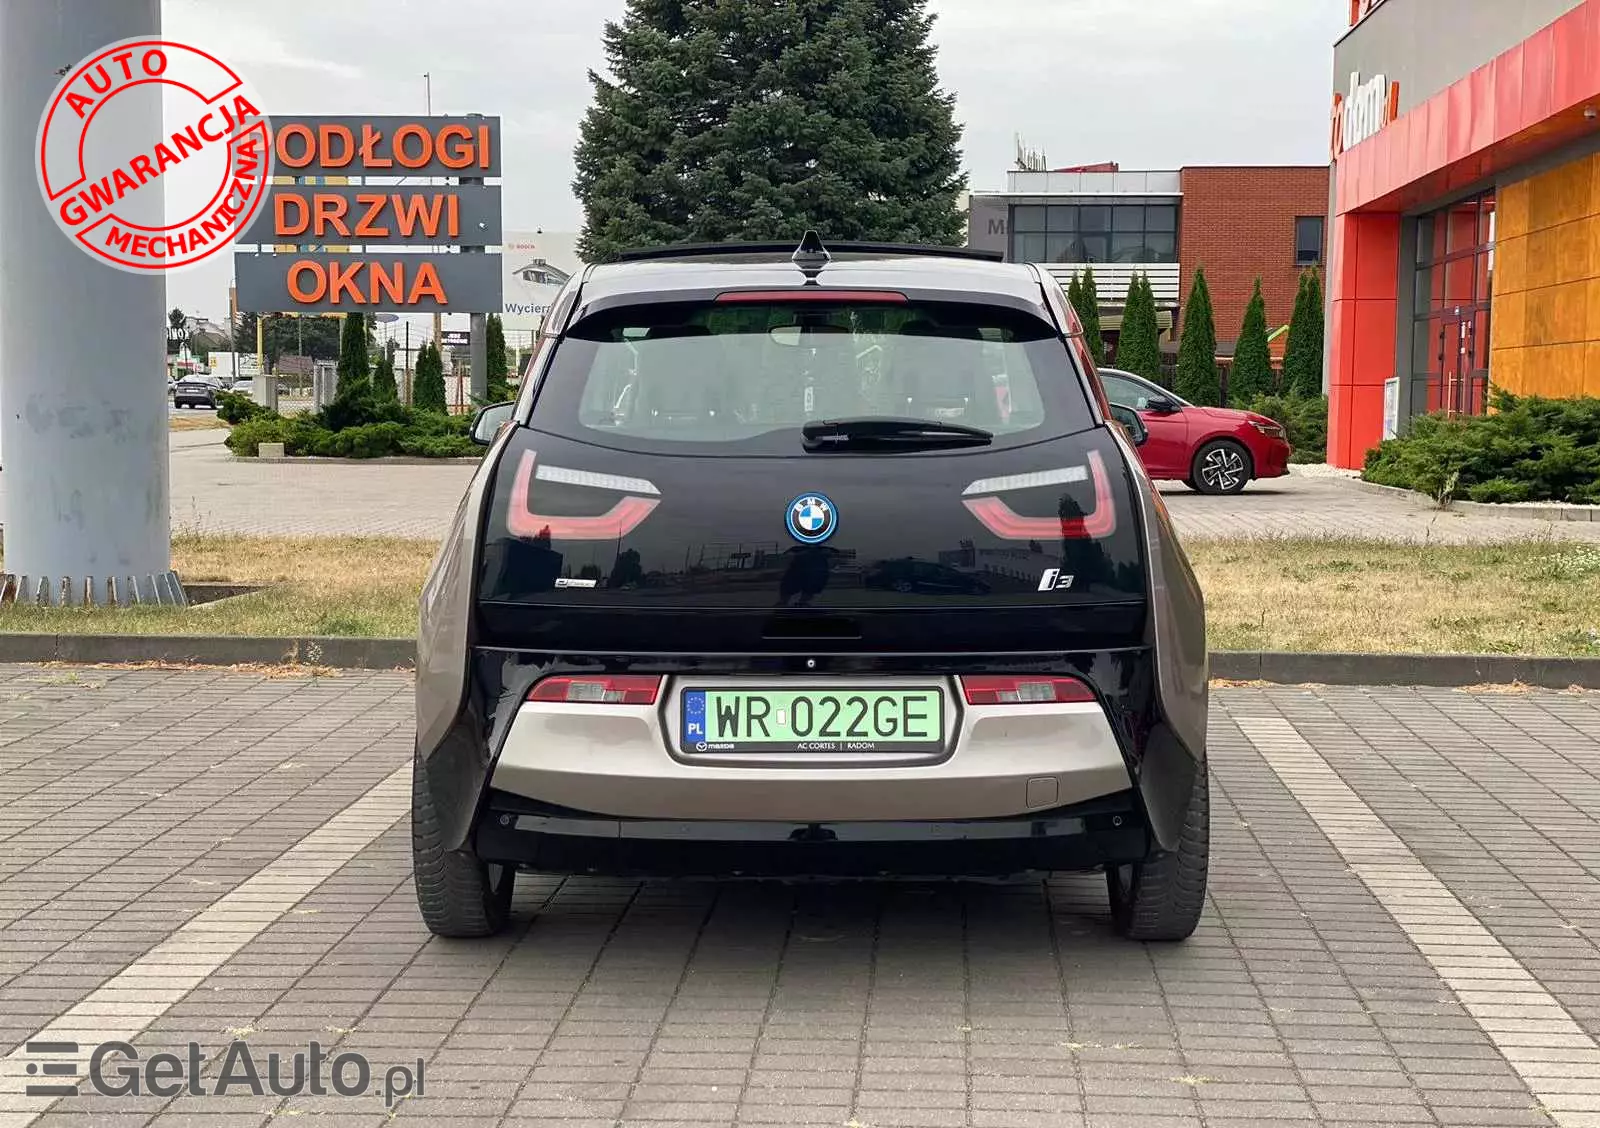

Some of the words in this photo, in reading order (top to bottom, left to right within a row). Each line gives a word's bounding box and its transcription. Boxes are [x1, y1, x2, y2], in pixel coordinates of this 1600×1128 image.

[273, 192, 460, 238] DRZWI
[286, 259, 449, 306] OKNA
[1038, 568, 1074, 591] i3
[688, 723, 704, 735] PL
[716, 696, 771, 738] WR
[791, 695, 928, 738] 022GE
